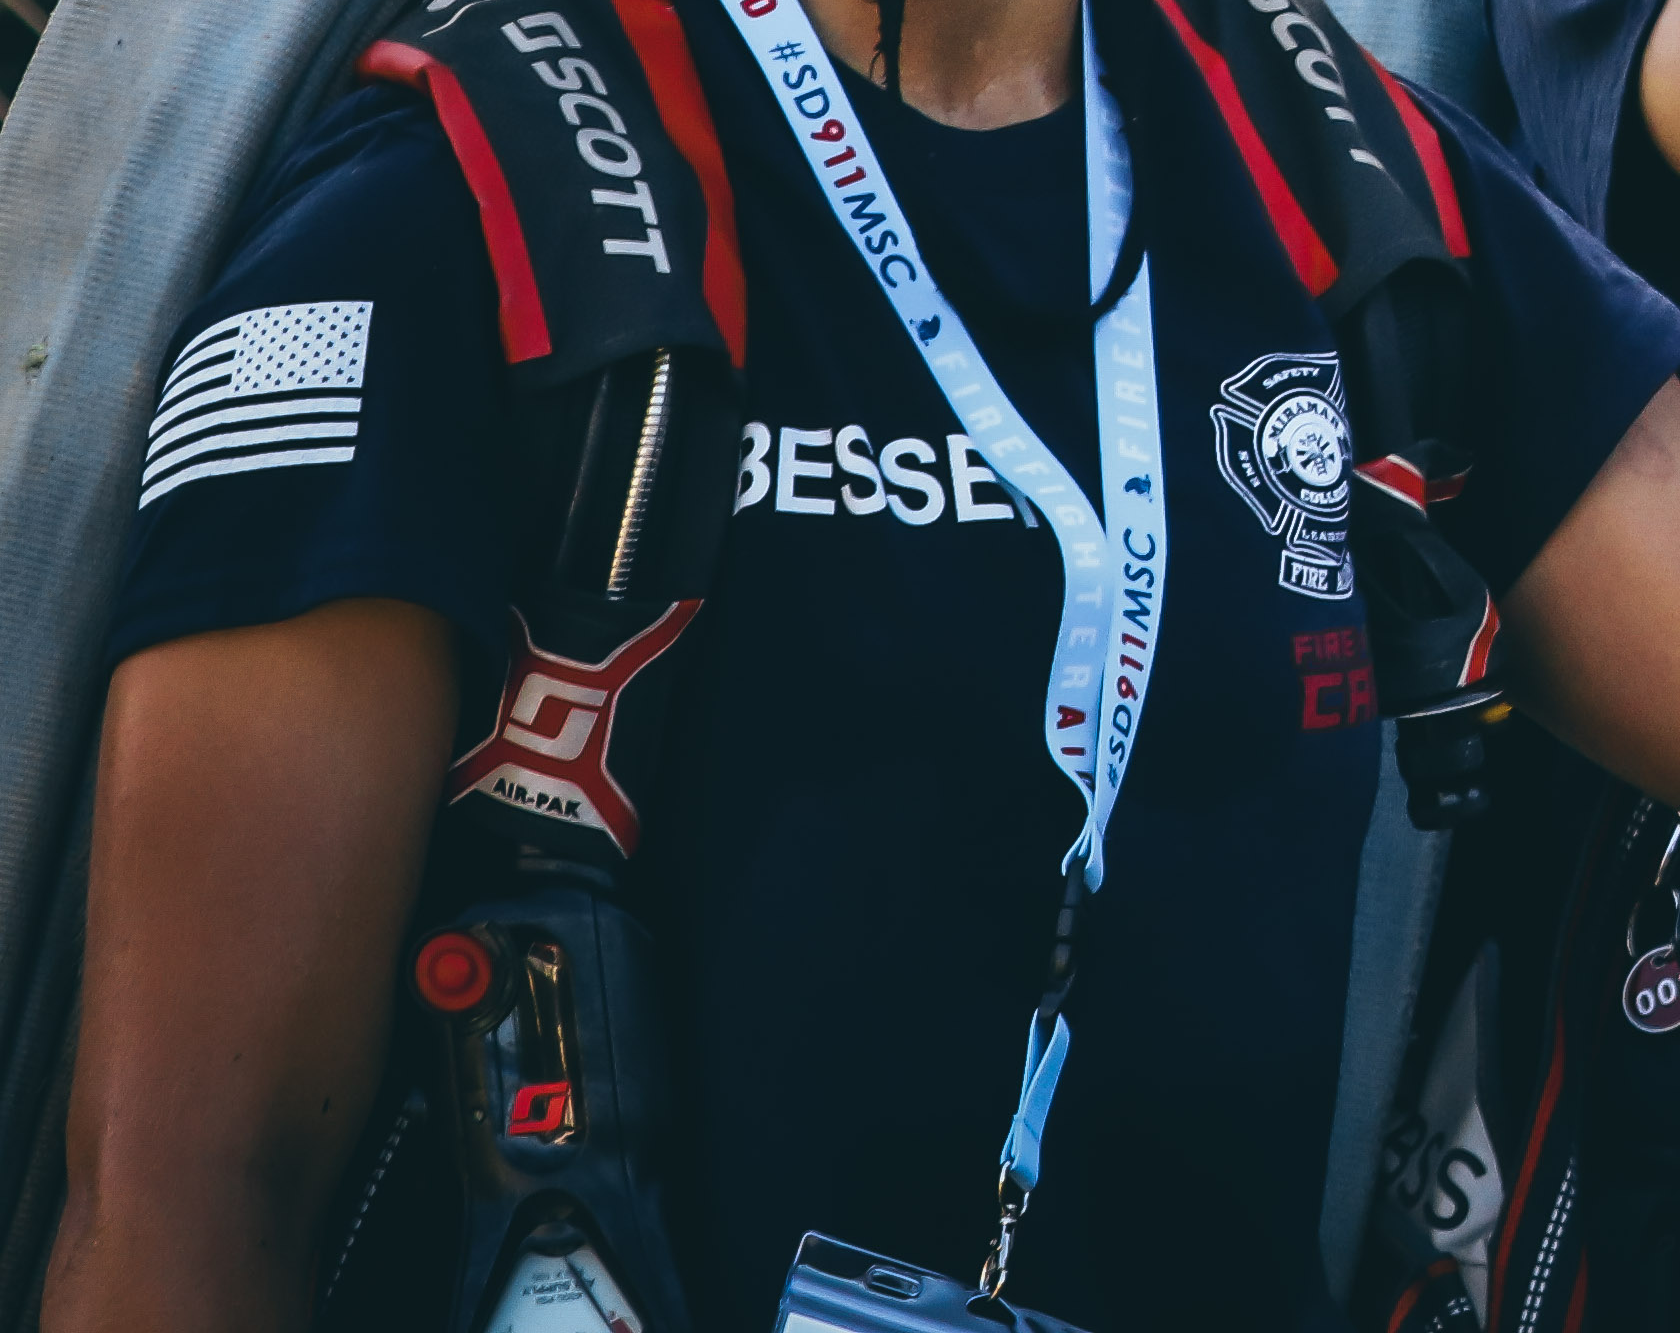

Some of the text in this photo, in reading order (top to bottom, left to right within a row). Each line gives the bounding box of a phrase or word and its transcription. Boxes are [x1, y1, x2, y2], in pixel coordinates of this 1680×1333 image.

[529, 54, 671, 275] SCOTT
[768, 39, 917, 289] #SD911MSC
[732, 421, 1040, 529] BESSE
[1290, 561, 1328, 592] FIRE
[491, 777, 582, 819] AIR-PAK
